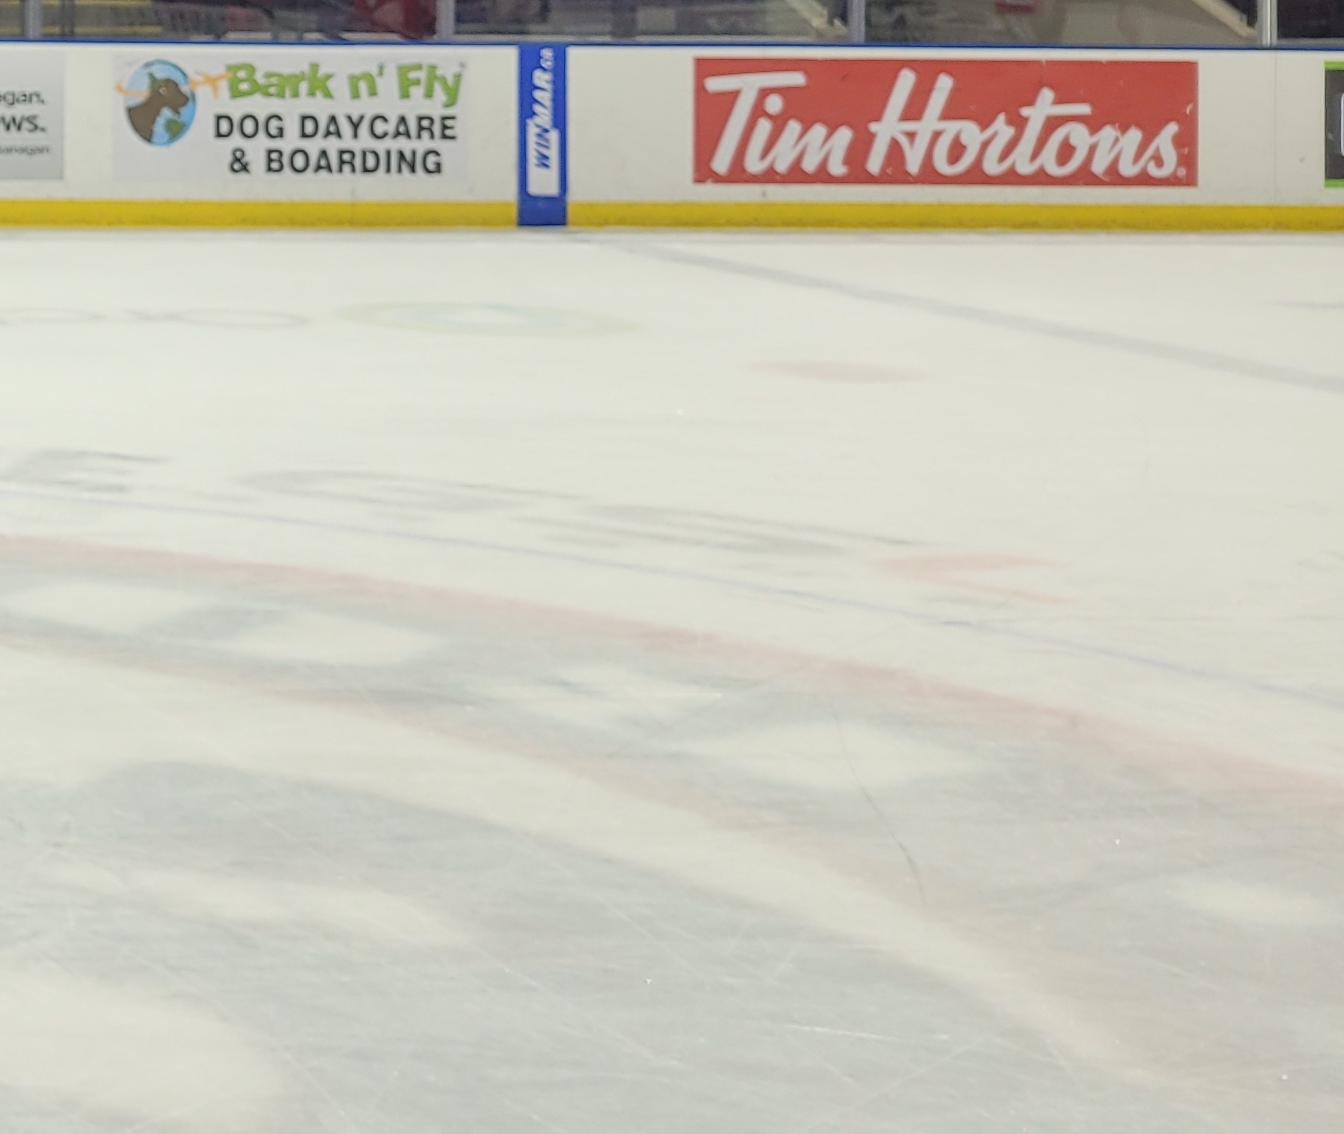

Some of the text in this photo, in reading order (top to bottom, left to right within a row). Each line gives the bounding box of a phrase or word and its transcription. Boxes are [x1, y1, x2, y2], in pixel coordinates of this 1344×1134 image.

[226, 62, 462, 108] Bark n' Fly
[214, 114, 458, 141] DOG DAYCARE
[703, 67, 1182, 181] Tim Hortons
[230, 148, 443, 175] & BOARDING
